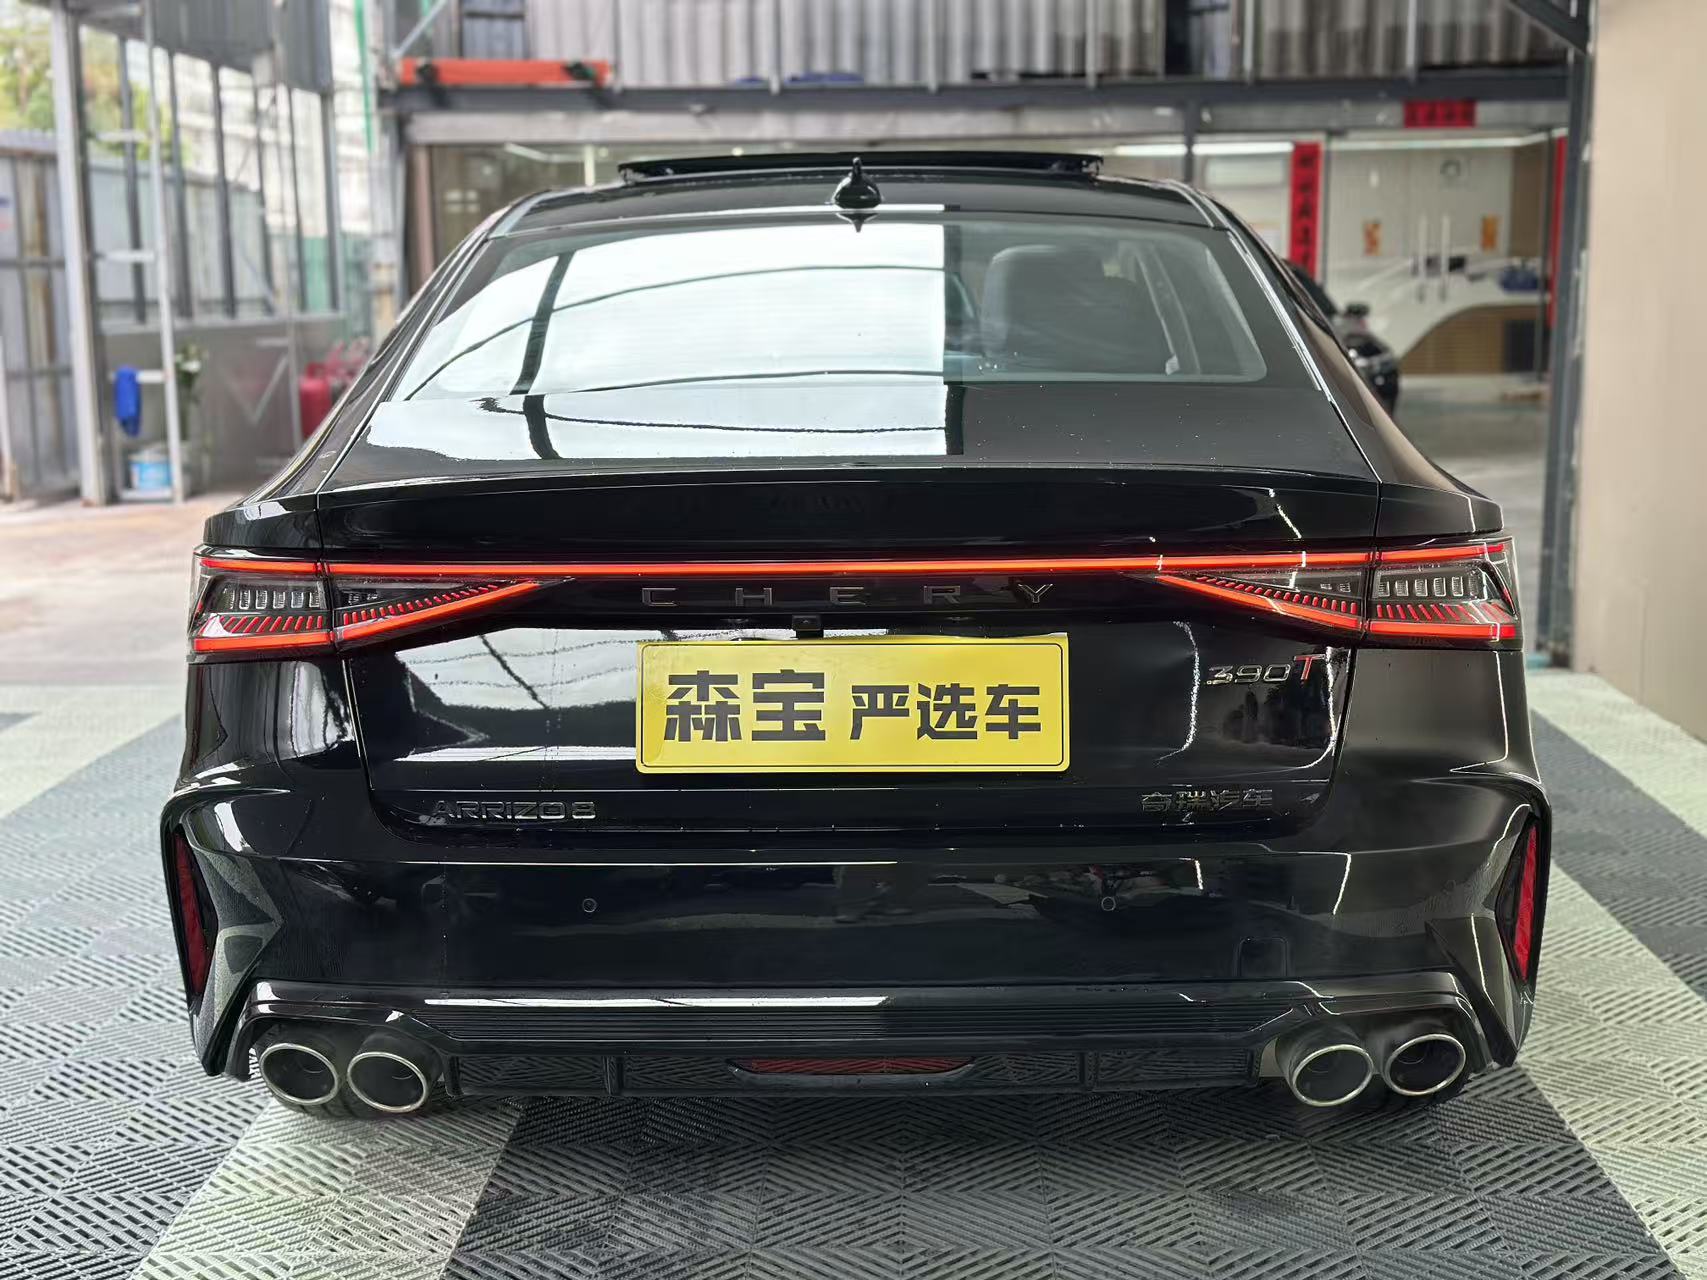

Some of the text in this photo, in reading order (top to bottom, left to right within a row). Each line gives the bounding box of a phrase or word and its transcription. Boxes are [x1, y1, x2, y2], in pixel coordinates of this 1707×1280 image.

[642, 584, 1053, 606] CHERY
[1206, 655, 1326, 684] 390T
[664, 669, 1042, 742] 森宝 严选车
[434, 800, 597, 820] ARRIZO 8
[1141, 788, 1273, 812] 奇瑞汽车
